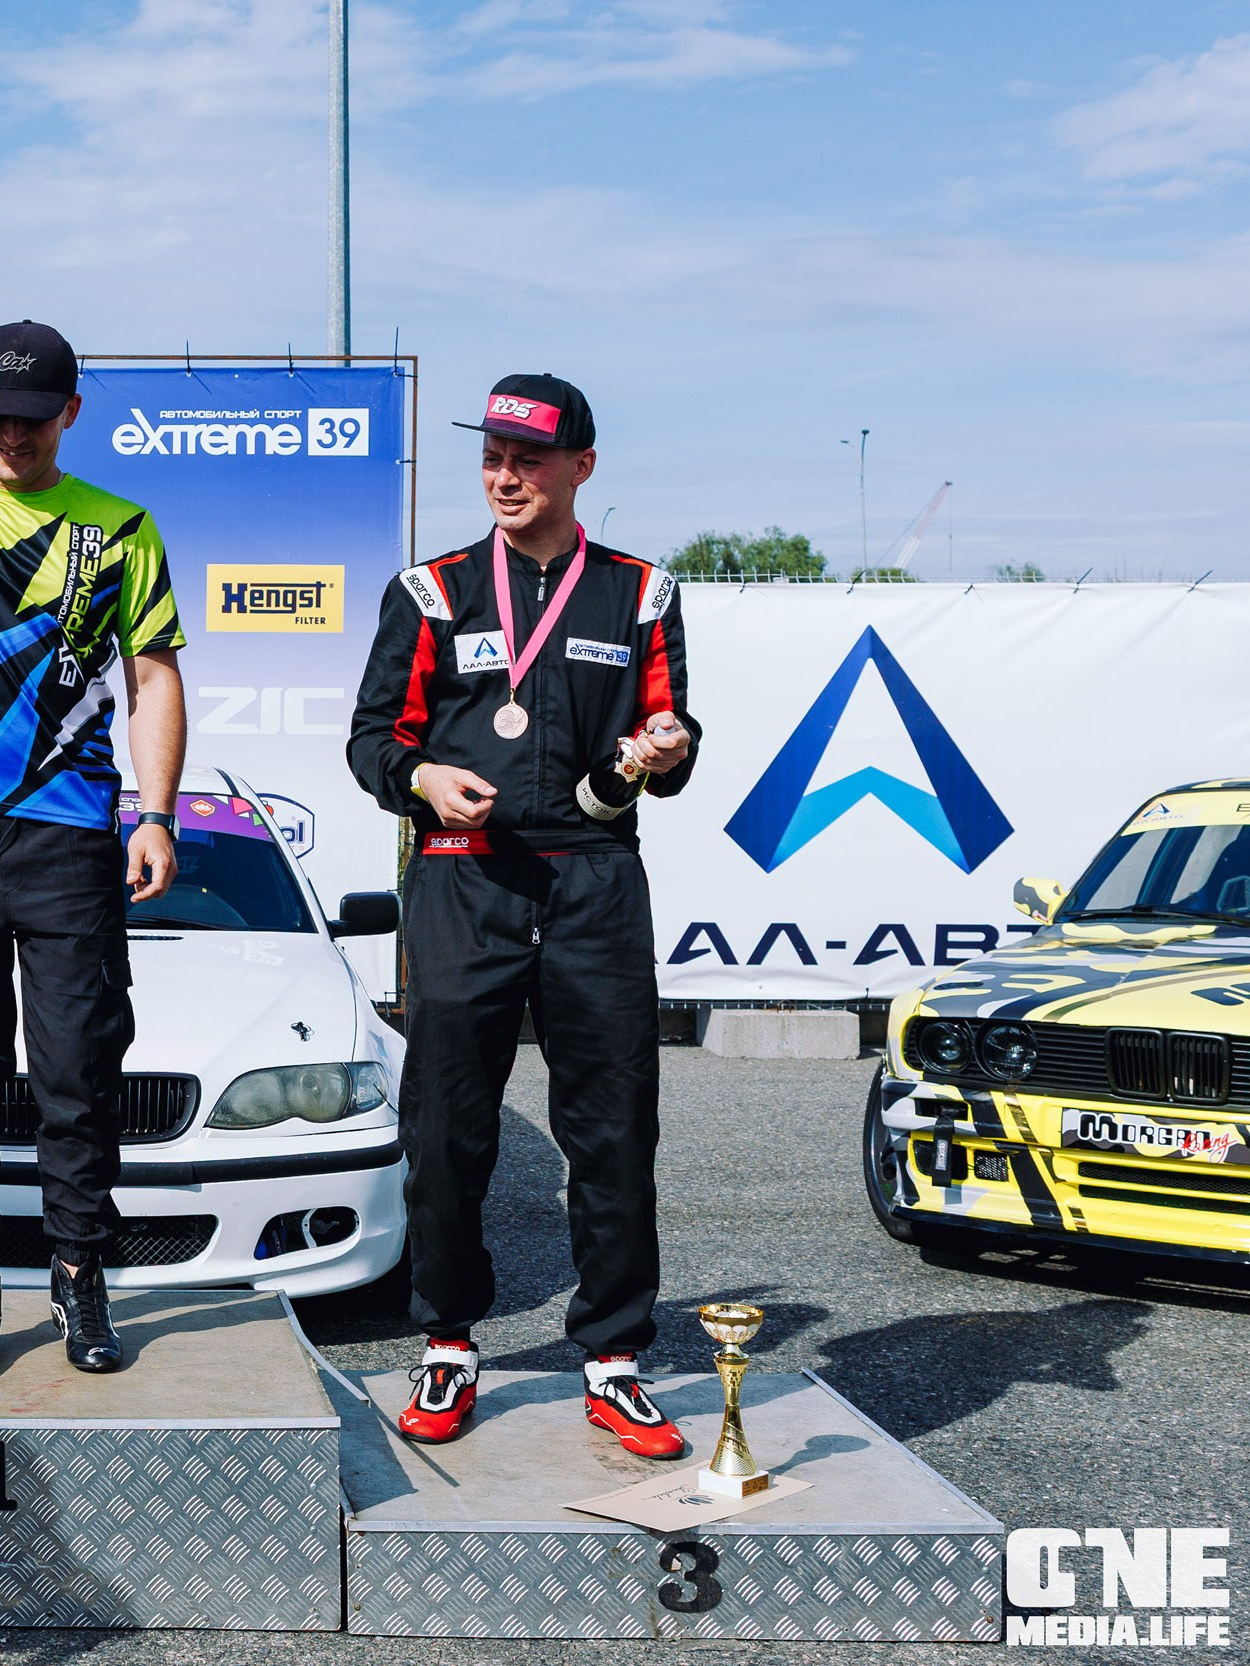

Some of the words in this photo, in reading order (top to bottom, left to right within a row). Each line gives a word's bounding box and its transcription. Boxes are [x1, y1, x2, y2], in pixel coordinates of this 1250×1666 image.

[159, 408, 260, 419] АВТОМОБИЛЬНЫЙ
[264, 410, 302, 419] СПОРТ
[491, 397, 538, 419] RDS
[316, 417, 362, 450] 39
[71, 523, 81, 550] СПОРТ
[221, 580, 327, 614] Hengst
[406, 573, 436, 610] sparco
[294, 616, 327, 625] FILTER
[196, 686, 345, 735] ZIC
[582, 786, 612, 816] ИСТОК
[428, 836, 470, 848] sparco
[658, 1540, 724, 1613] 3
